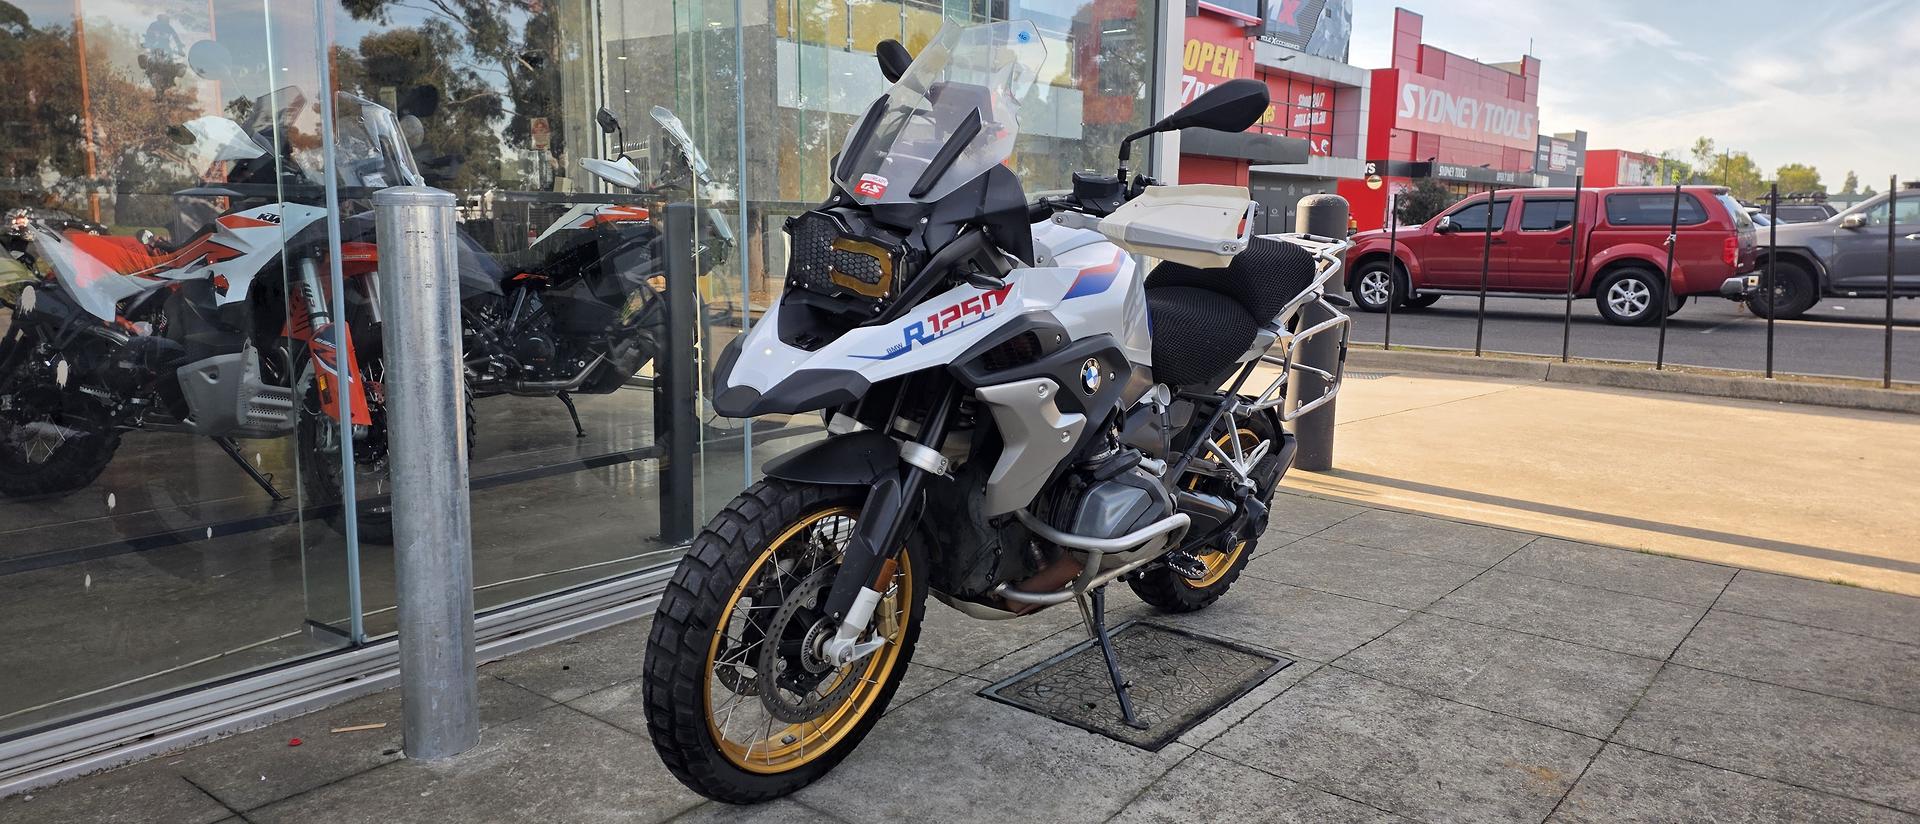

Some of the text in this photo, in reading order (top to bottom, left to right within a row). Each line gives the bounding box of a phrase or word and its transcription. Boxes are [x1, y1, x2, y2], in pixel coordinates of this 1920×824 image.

[1183, 39, 1240, 79] OPEN
[1398, 82, 1534, 140] SYDNEY TOOLS
[886, 341, 904, 354] BMW
